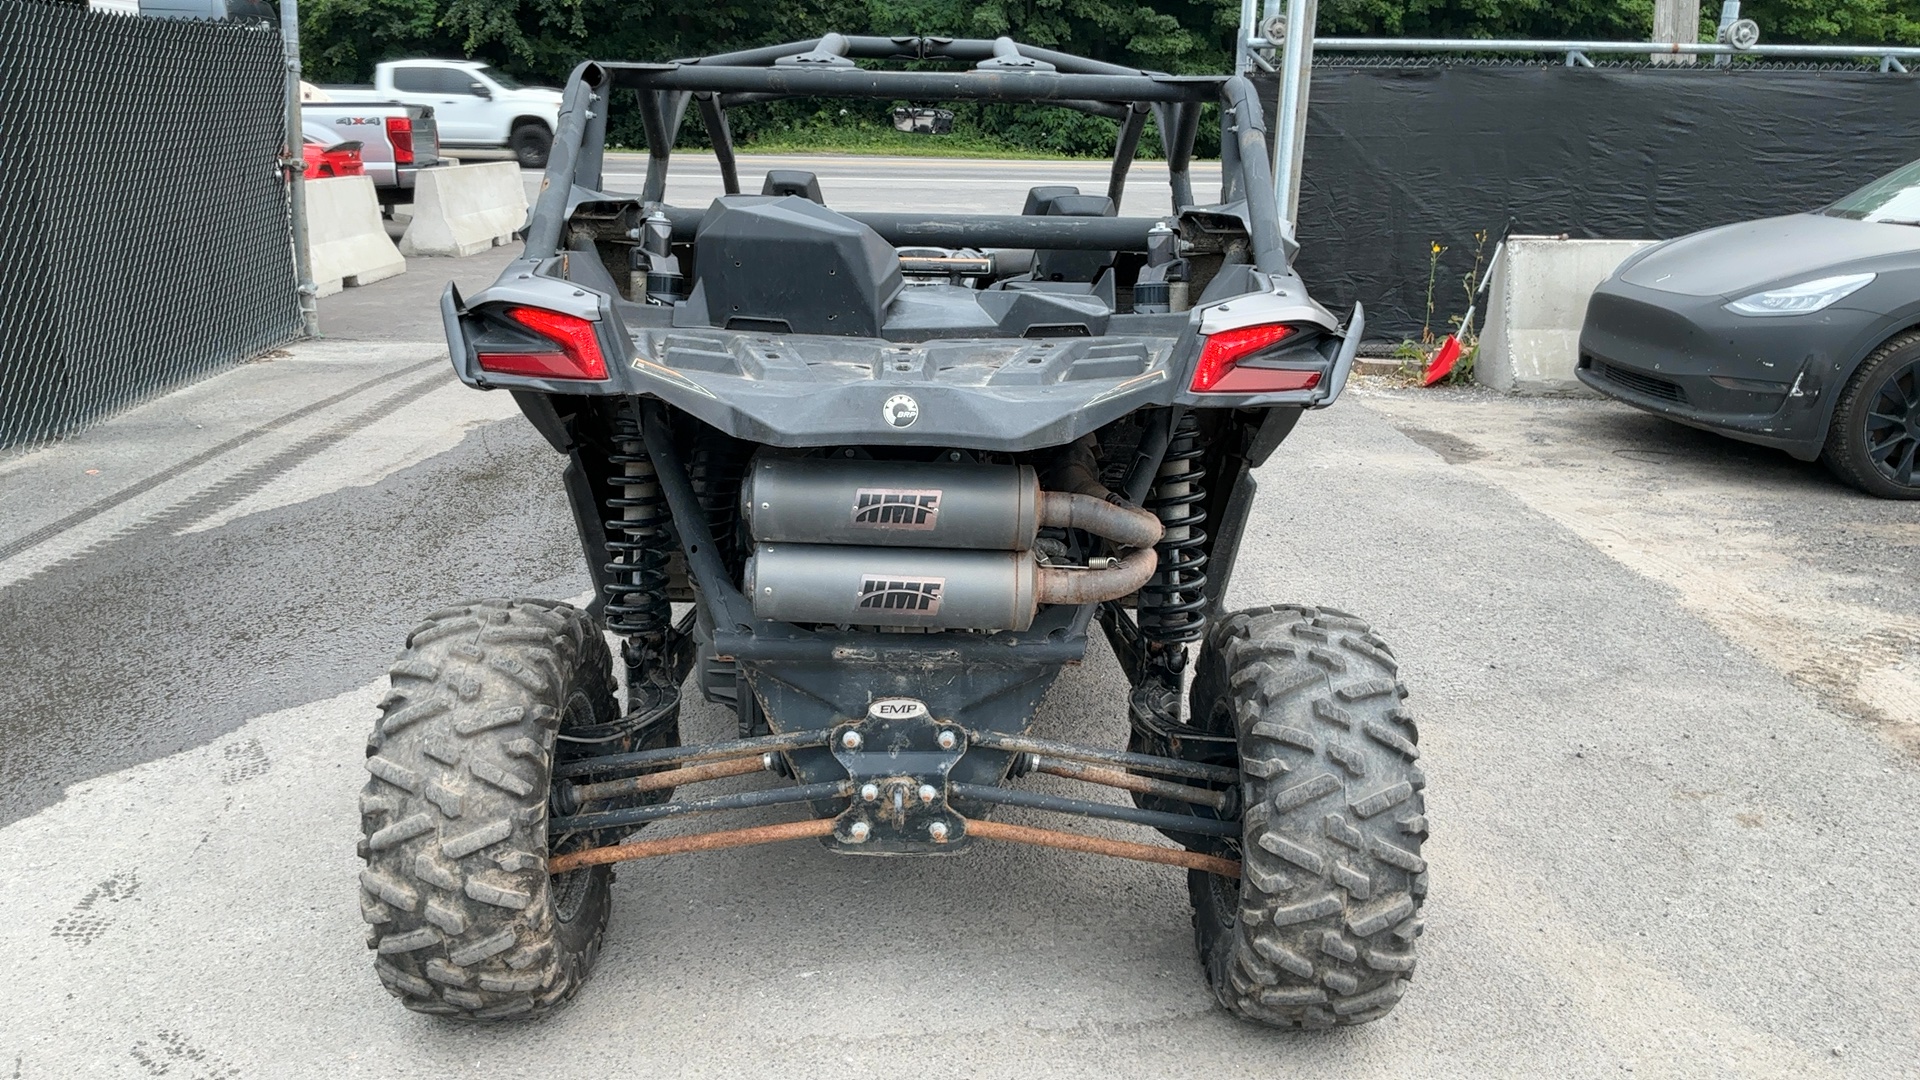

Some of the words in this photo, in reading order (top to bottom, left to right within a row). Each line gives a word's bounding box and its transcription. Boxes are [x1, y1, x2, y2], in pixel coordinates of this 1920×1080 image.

[856, 494, 938, 524] HMF
[860, 580, 941, 610] HMF
[880, 704, 918, 714] EMP
